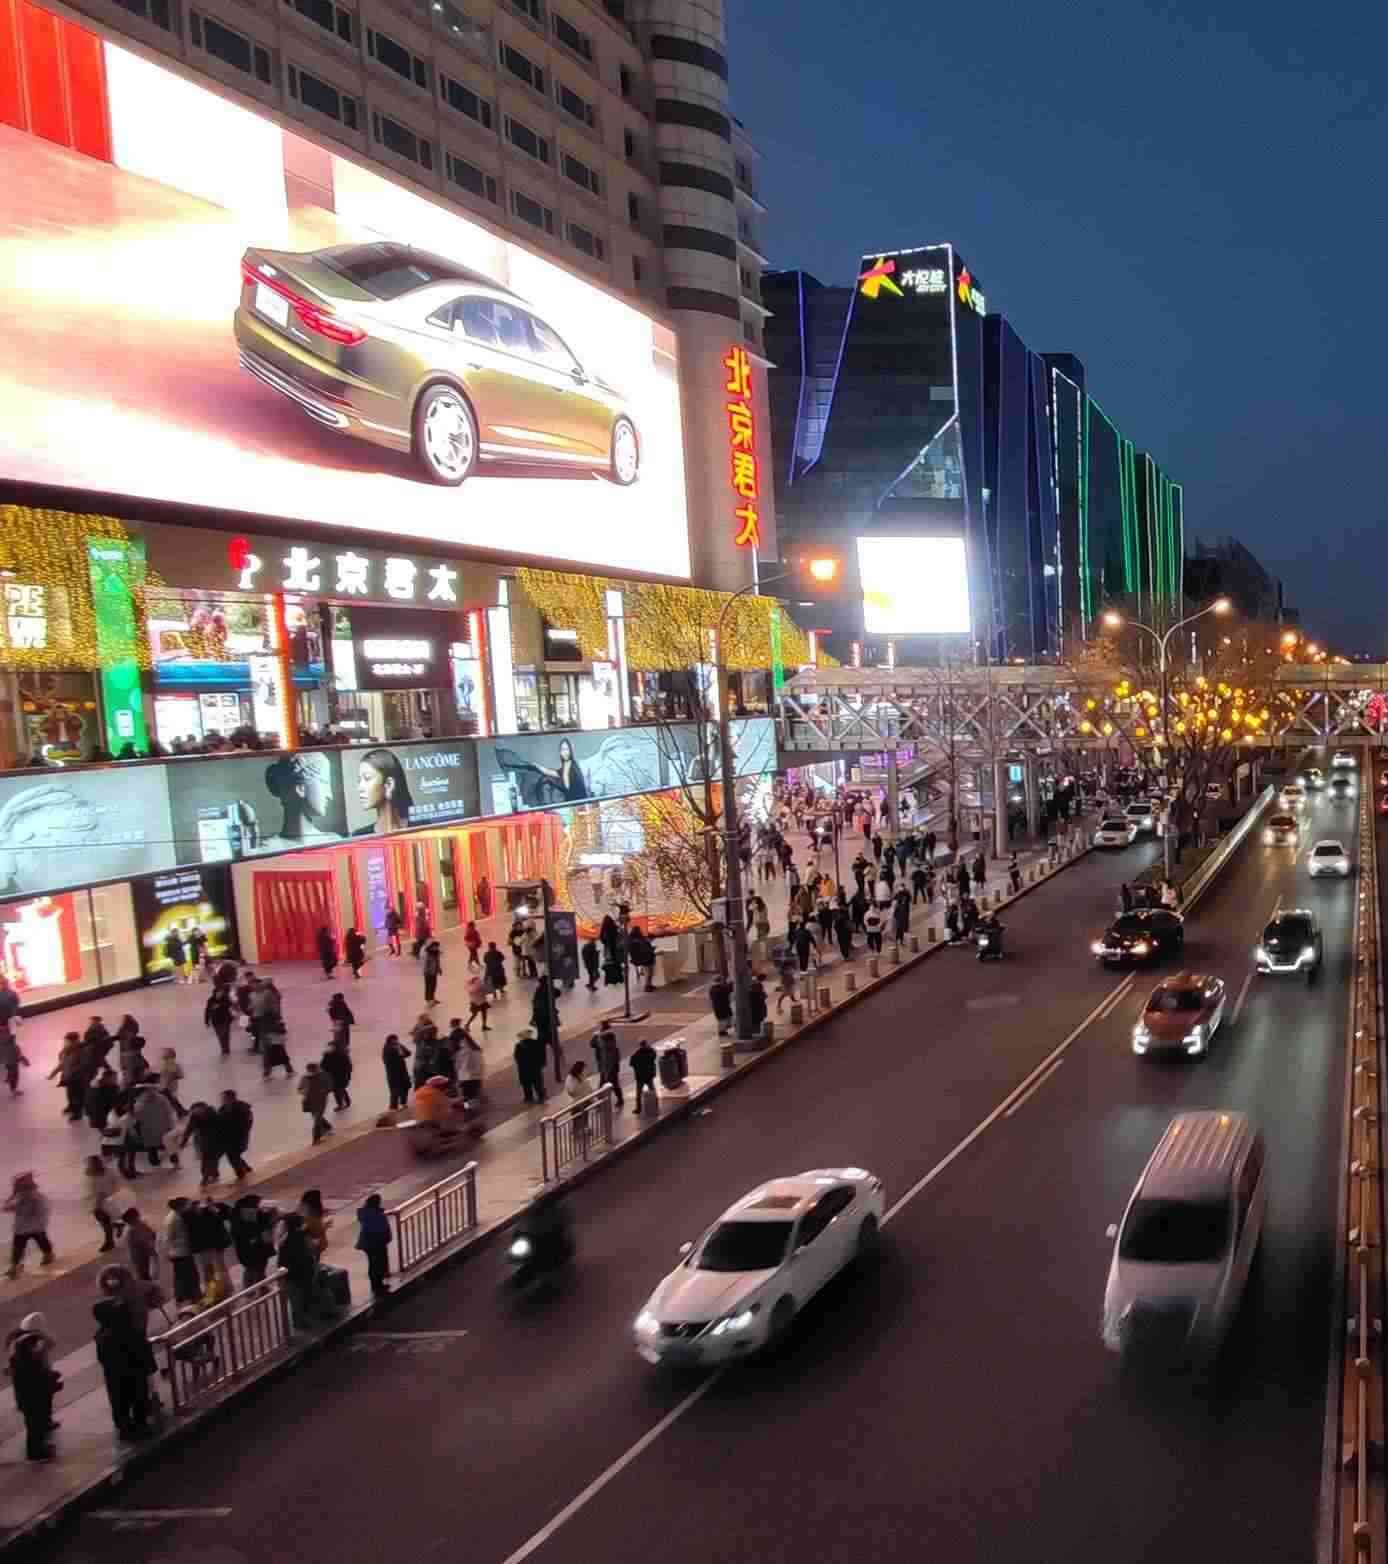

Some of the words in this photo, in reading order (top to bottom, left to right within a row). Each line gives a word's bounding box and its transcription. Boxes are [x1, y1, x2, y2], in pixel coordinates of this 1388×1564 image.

[724, 346, 760, 550] 北京君太
[282, 546, 458, 602] 北京君太
